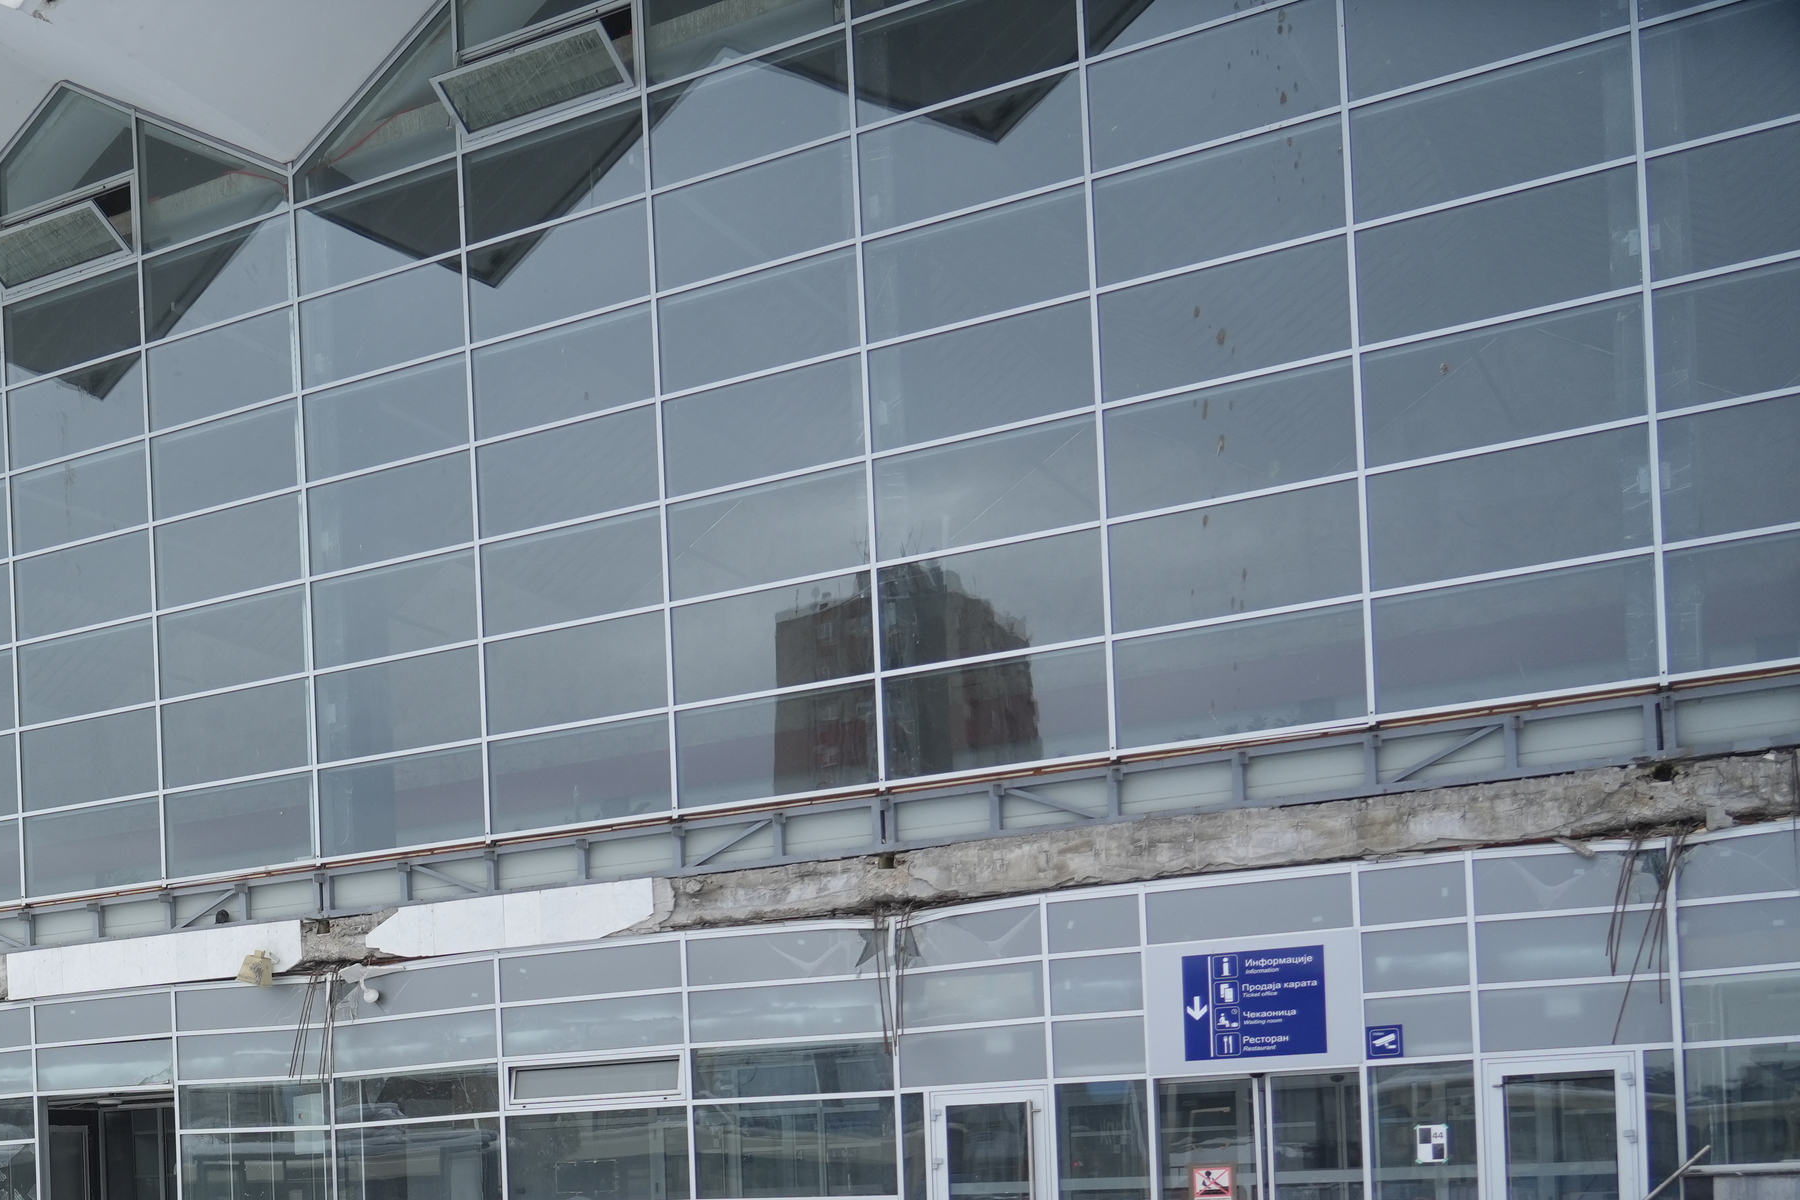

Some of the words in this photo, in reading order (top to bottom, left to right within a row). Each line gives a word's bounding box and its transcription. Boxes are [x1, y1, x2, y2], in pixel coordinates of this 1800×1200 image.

[1244, 954, 1313, 969] Информације
[1241, 981, 1282, 992] Продаја
[1283, 980, 1318, 989] карата
[1243, 1009, 1297, 1018] Чекаоница
[1243, 1035, 1289, 1044] Ресторан
[1432, 1131, 1444, 1139] 44
